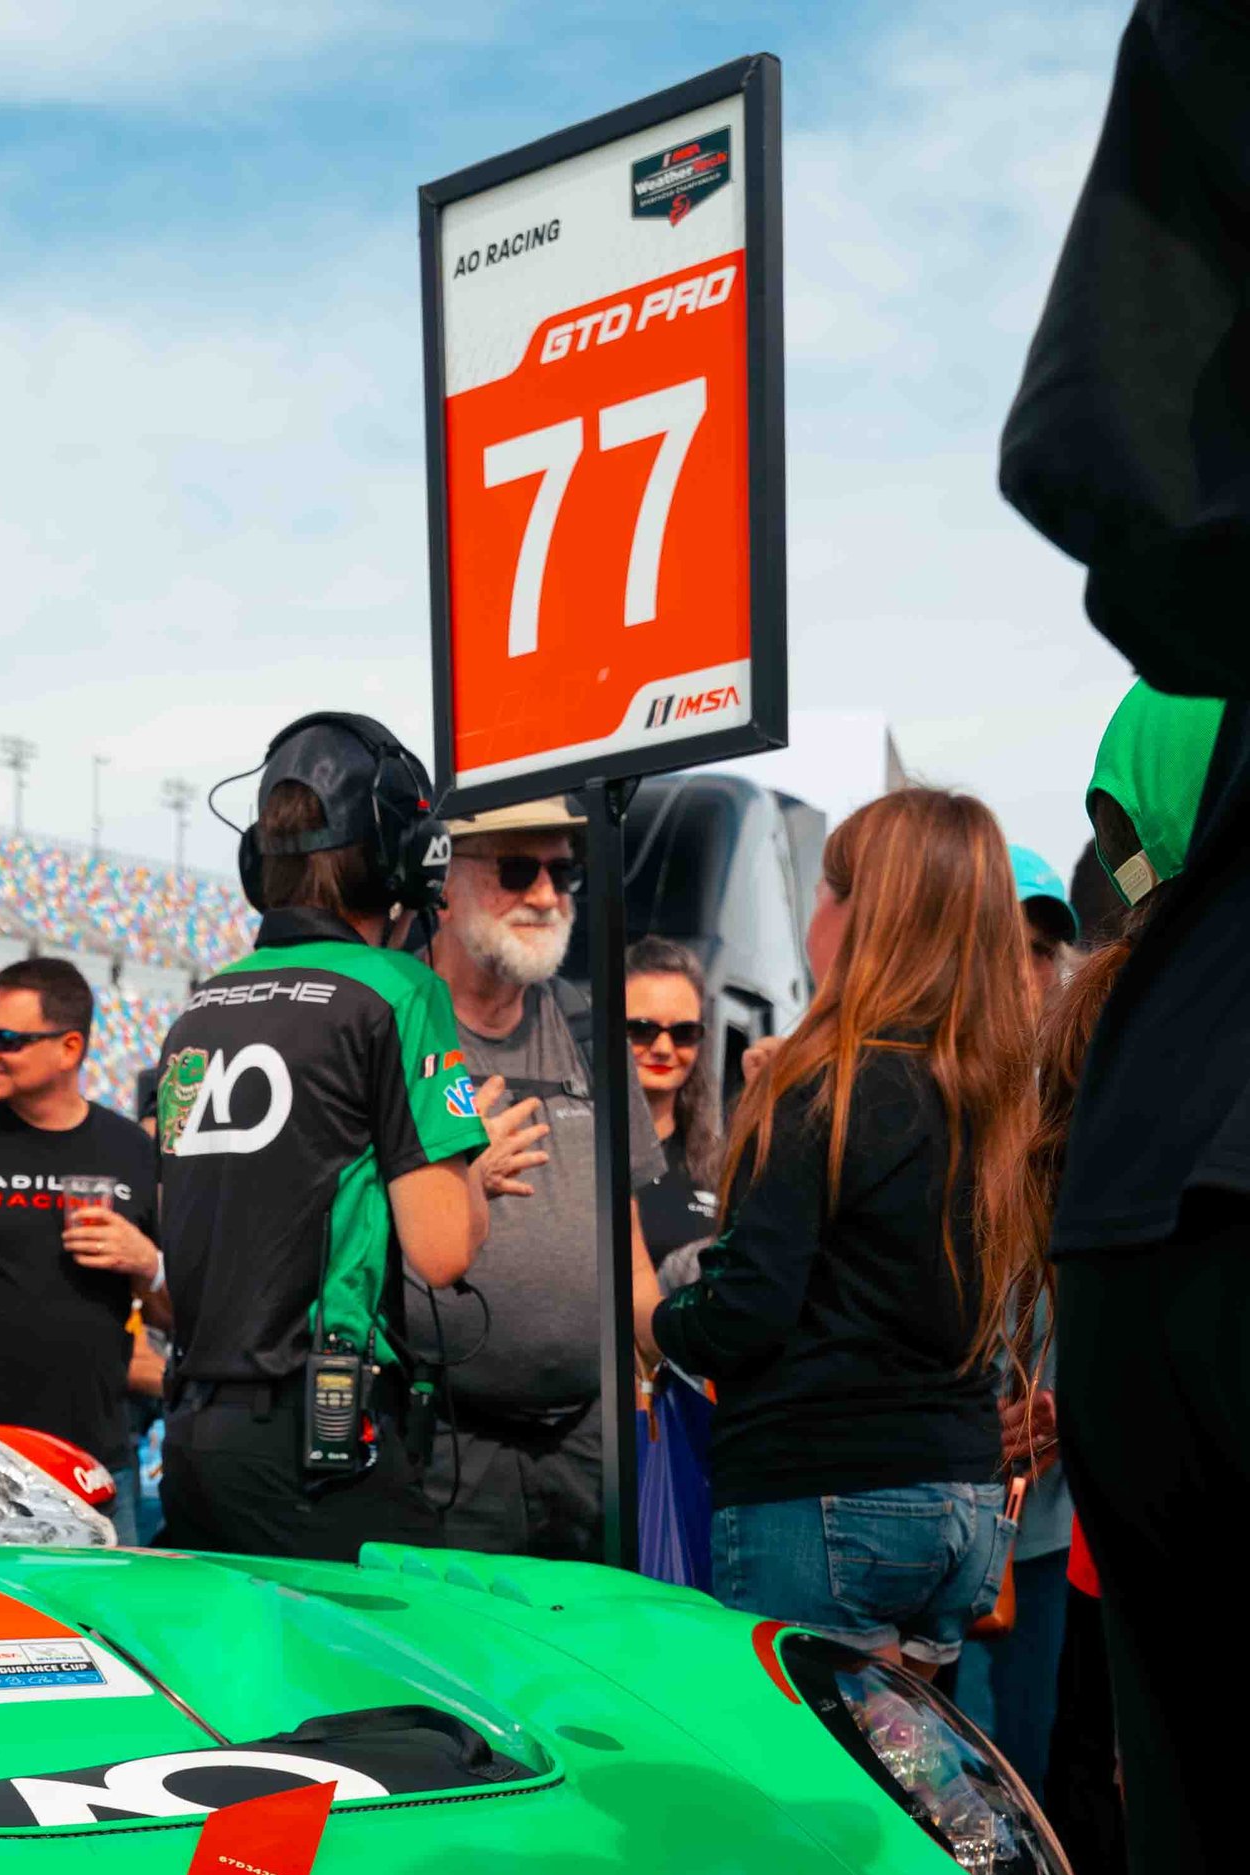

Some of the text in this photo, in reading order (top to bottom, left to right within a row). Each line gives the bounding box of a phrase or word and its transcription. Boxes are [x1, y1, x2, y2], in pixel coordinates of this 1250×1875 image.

[454, 219, 561, 279] AO RACING
[540, 265, 738, 365] GTD PRO
[483, 376, 708, 659] 77
[675, 685, 741, 721] IMSA
[187, 981, 338, 1011] ORSCHE
